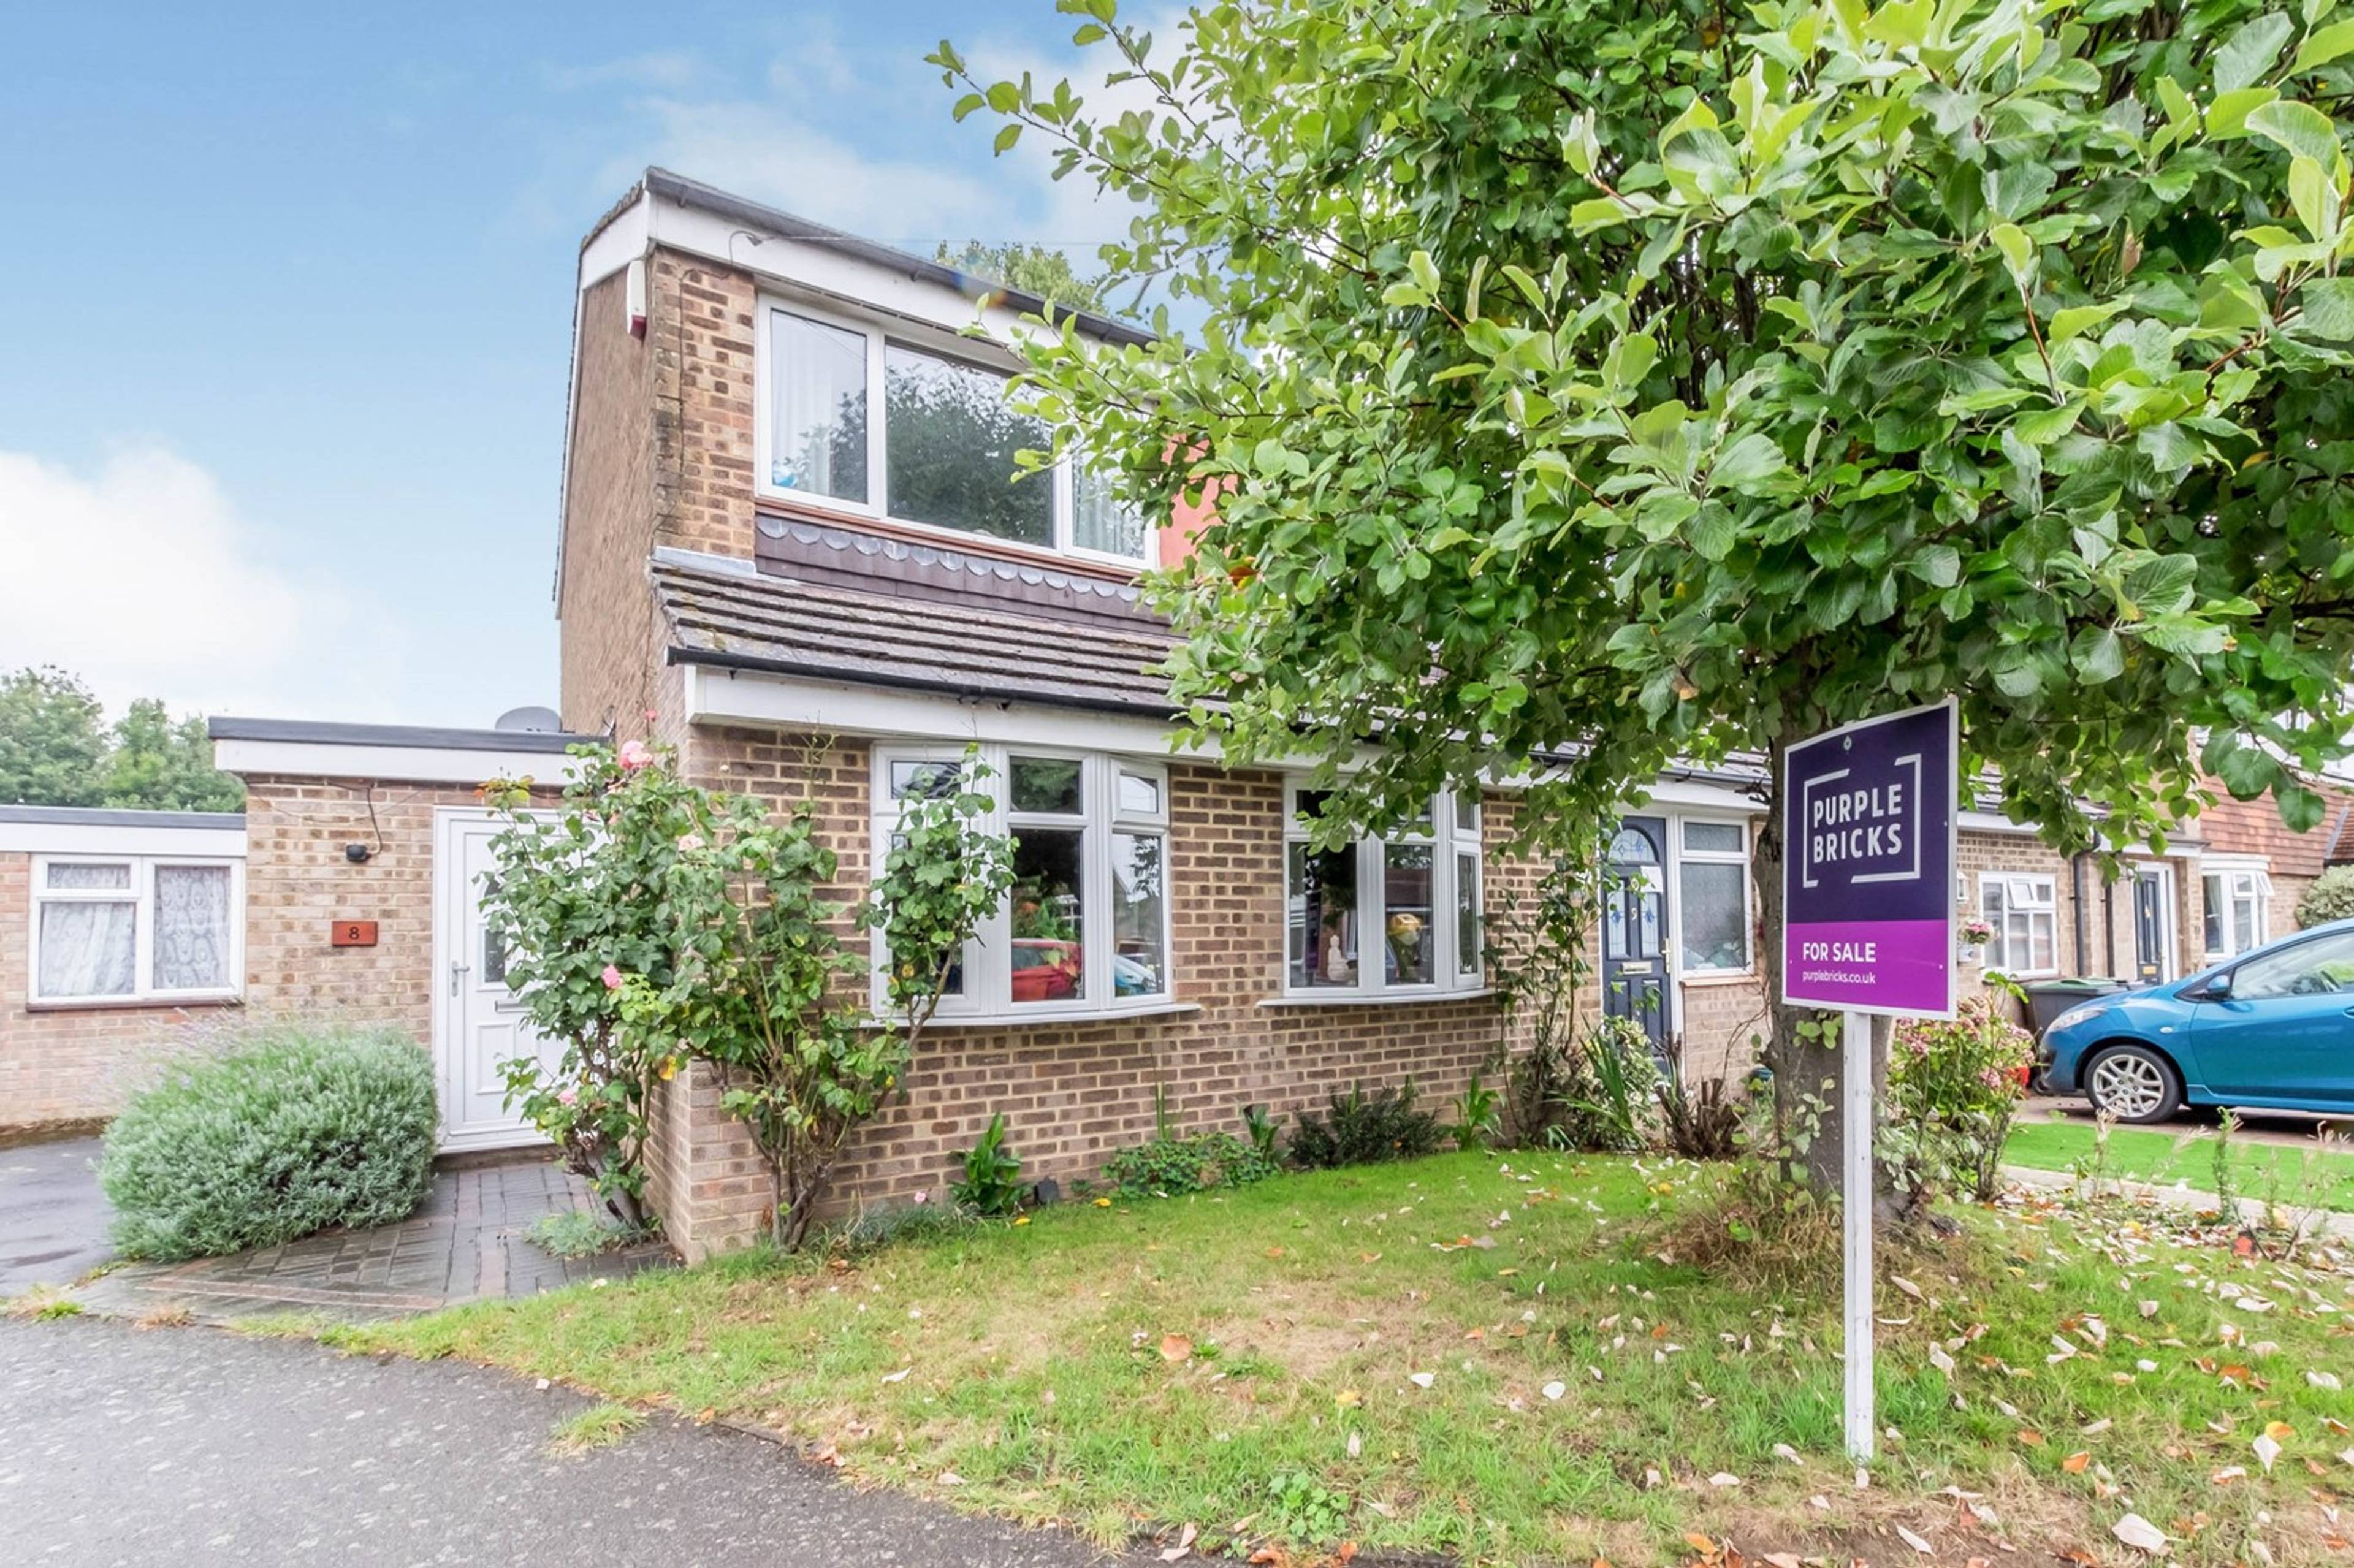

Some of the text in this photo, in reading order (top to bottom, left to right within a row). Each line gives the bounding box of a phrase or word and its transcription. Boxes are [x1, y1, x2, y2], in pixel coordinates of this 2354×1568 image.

[1813, 783, 1902, 828] PURPLE
[1813, 823, 1902, 863] BRICKS
[1631, 907, 1638, 921] 9
[349, 926, 360, 940] 8
[1803, 942, 1876, 962] FOR SALE
[1802, 970, 1876, 984] purplebricks.co.uk
